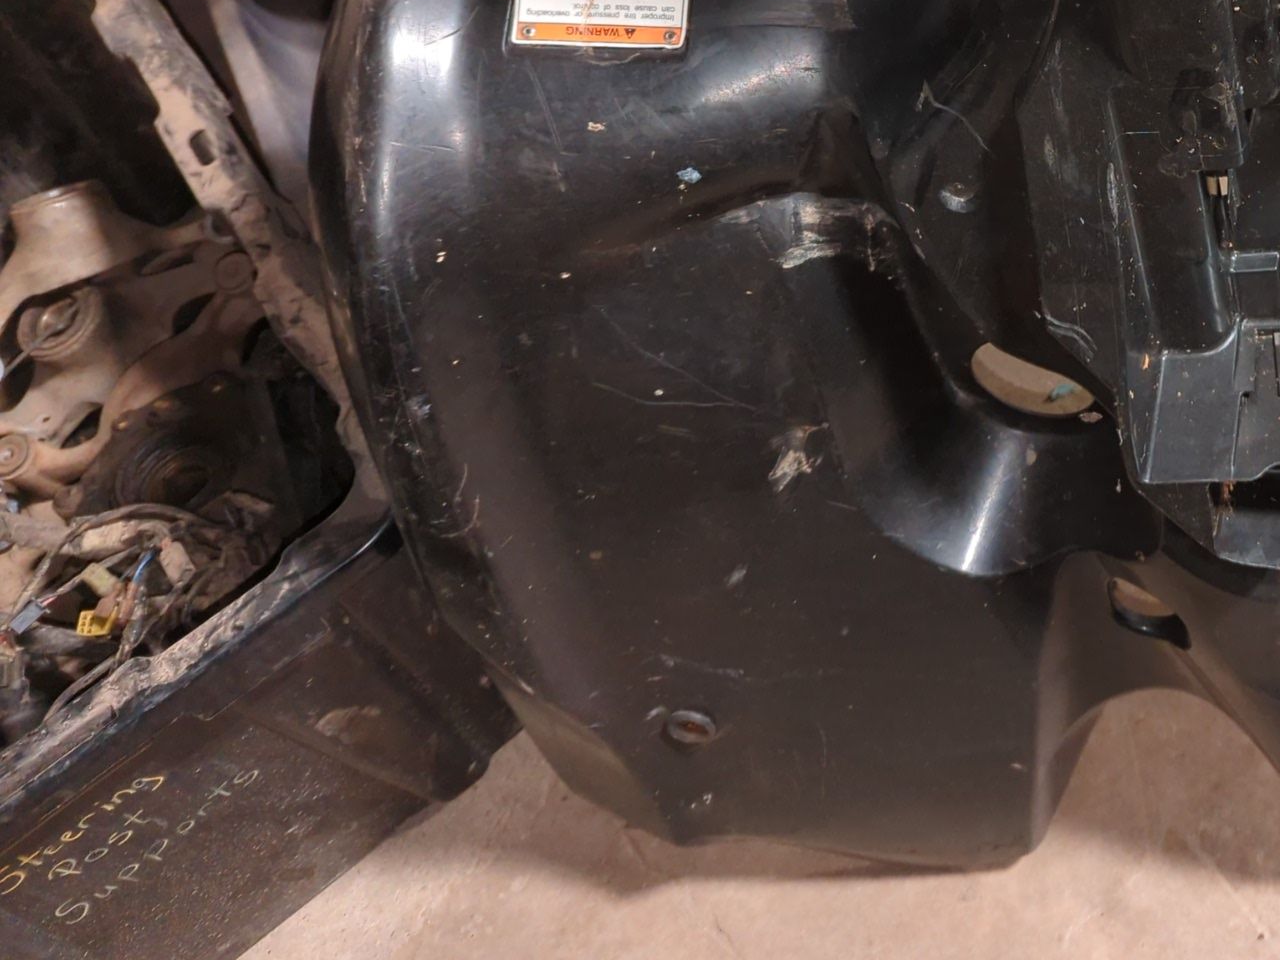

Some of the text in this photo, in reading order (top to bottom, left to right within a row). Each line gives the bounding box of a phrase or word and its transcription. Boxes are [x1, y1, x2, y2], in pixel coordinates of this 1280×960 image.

[526, 8, 570, 17] overloading
[565, 27, 620, 36] WARNING
[640, 13, 674, 21] Improper
[0, 773, 167, 896] Steering
[48, 809, 147, 881] Post
[55, 769, 260, 925] Supports
